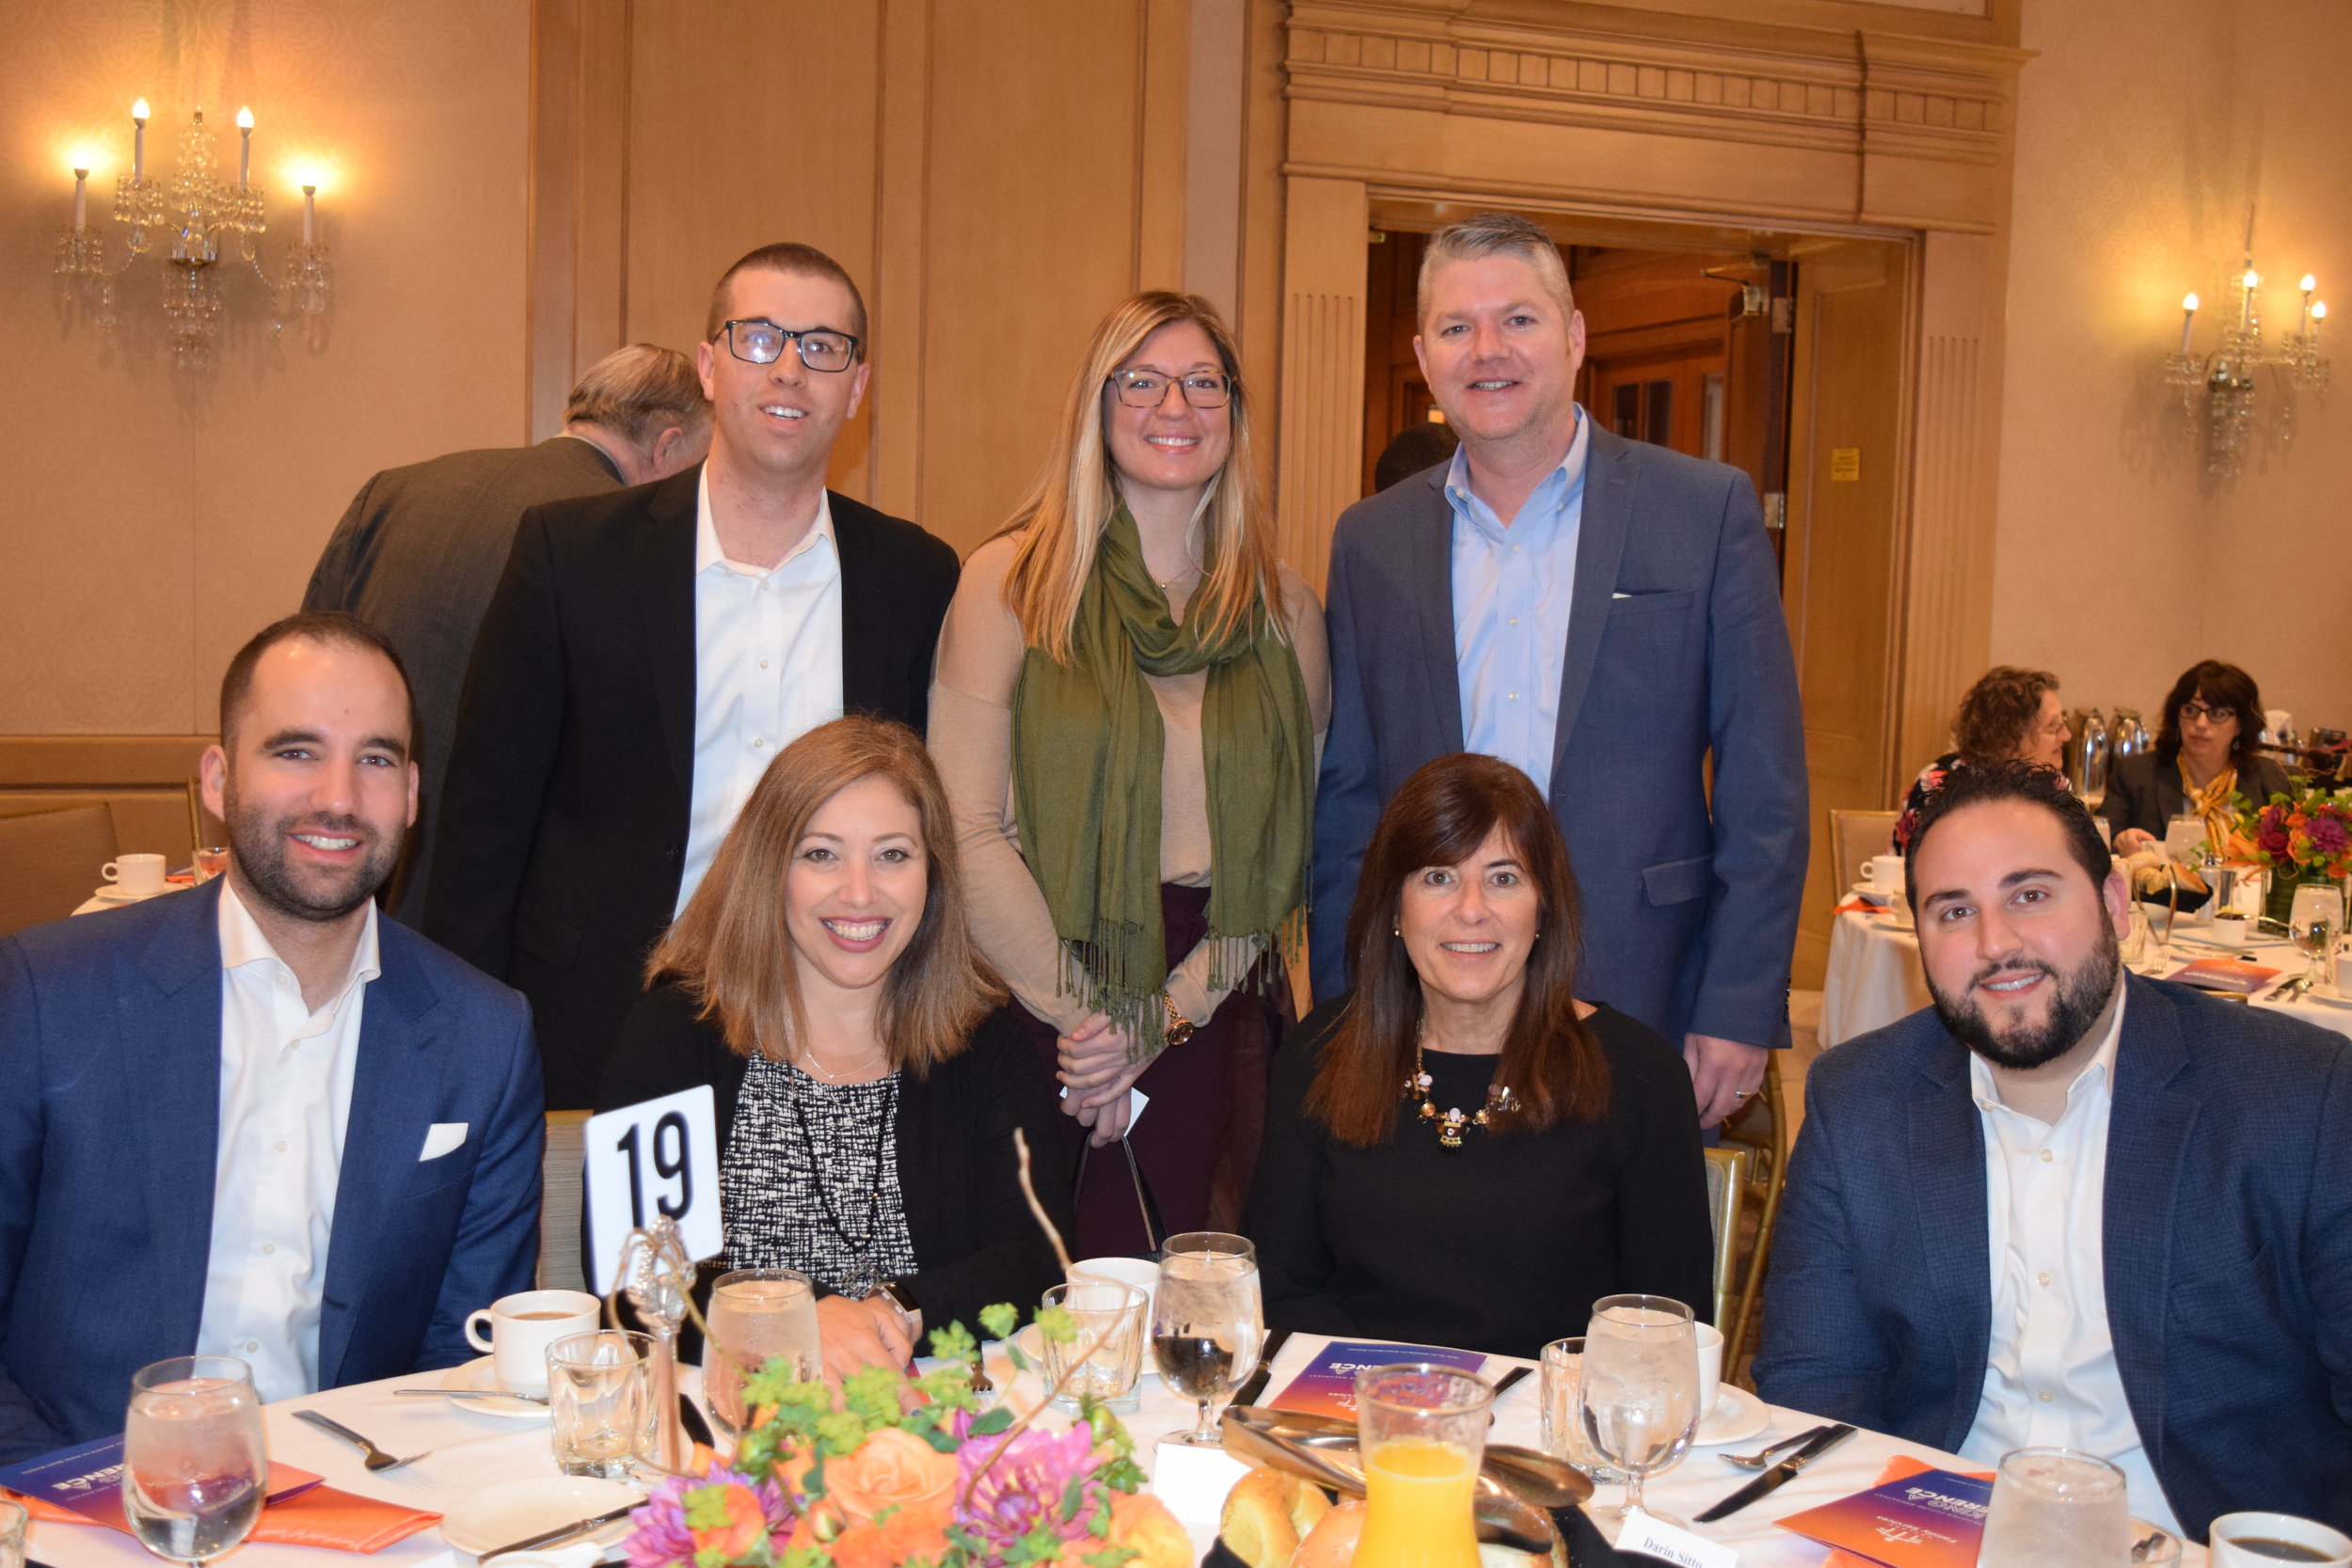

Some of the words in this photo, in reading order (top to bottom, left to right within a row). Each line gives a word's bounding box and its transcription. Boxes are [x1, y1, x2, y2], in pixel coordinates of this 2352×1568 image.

[616, 1110, 693, 1230] 19
[1876, 1515, 1920, 1532] Services
[1922, 1528, 1957, 1544] Family
[1644, 1537, 1675, 1559] Darin
[1677, 1550, 1703, 1568] Sitto
